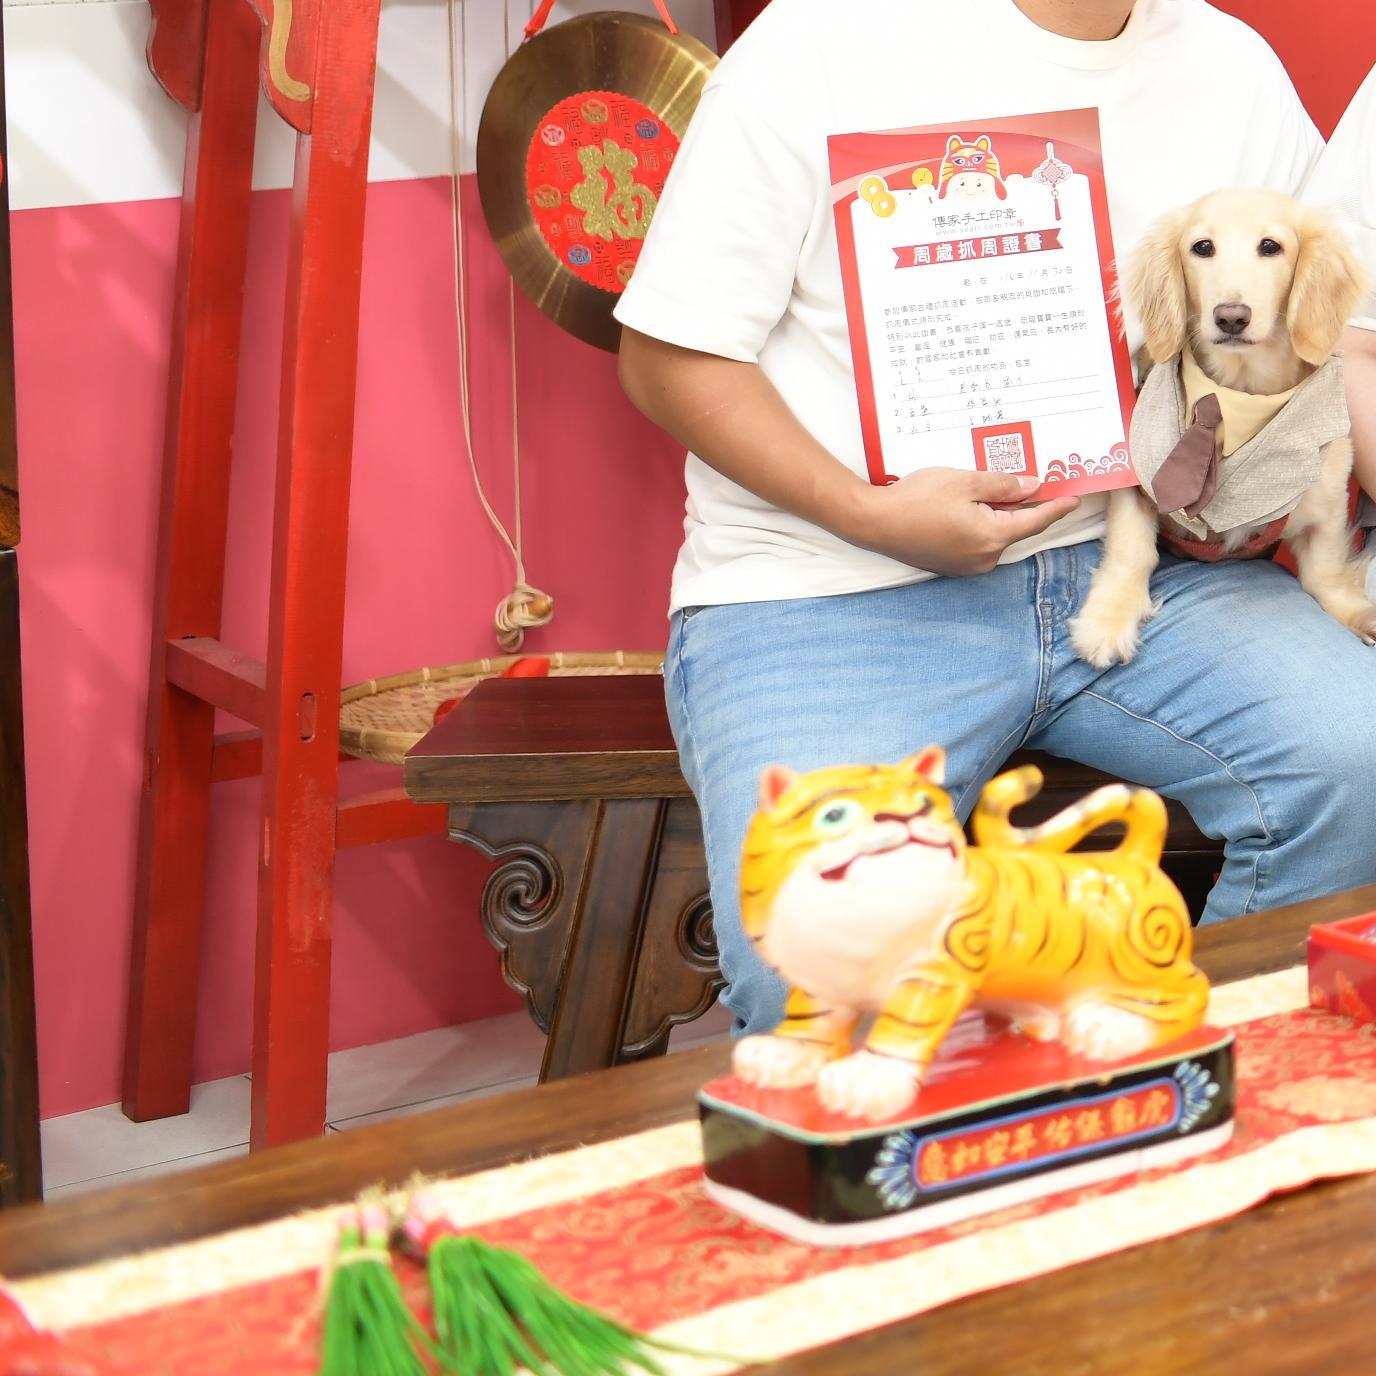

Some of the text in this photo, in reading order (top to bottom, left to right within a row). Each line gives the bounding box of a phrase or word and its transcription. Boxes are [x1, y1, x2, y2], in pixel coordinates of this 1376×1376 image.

[932, 207, 1017, 229] 傳家手工印章
[912, 232, 1044, 265] 周歲抓周證書
